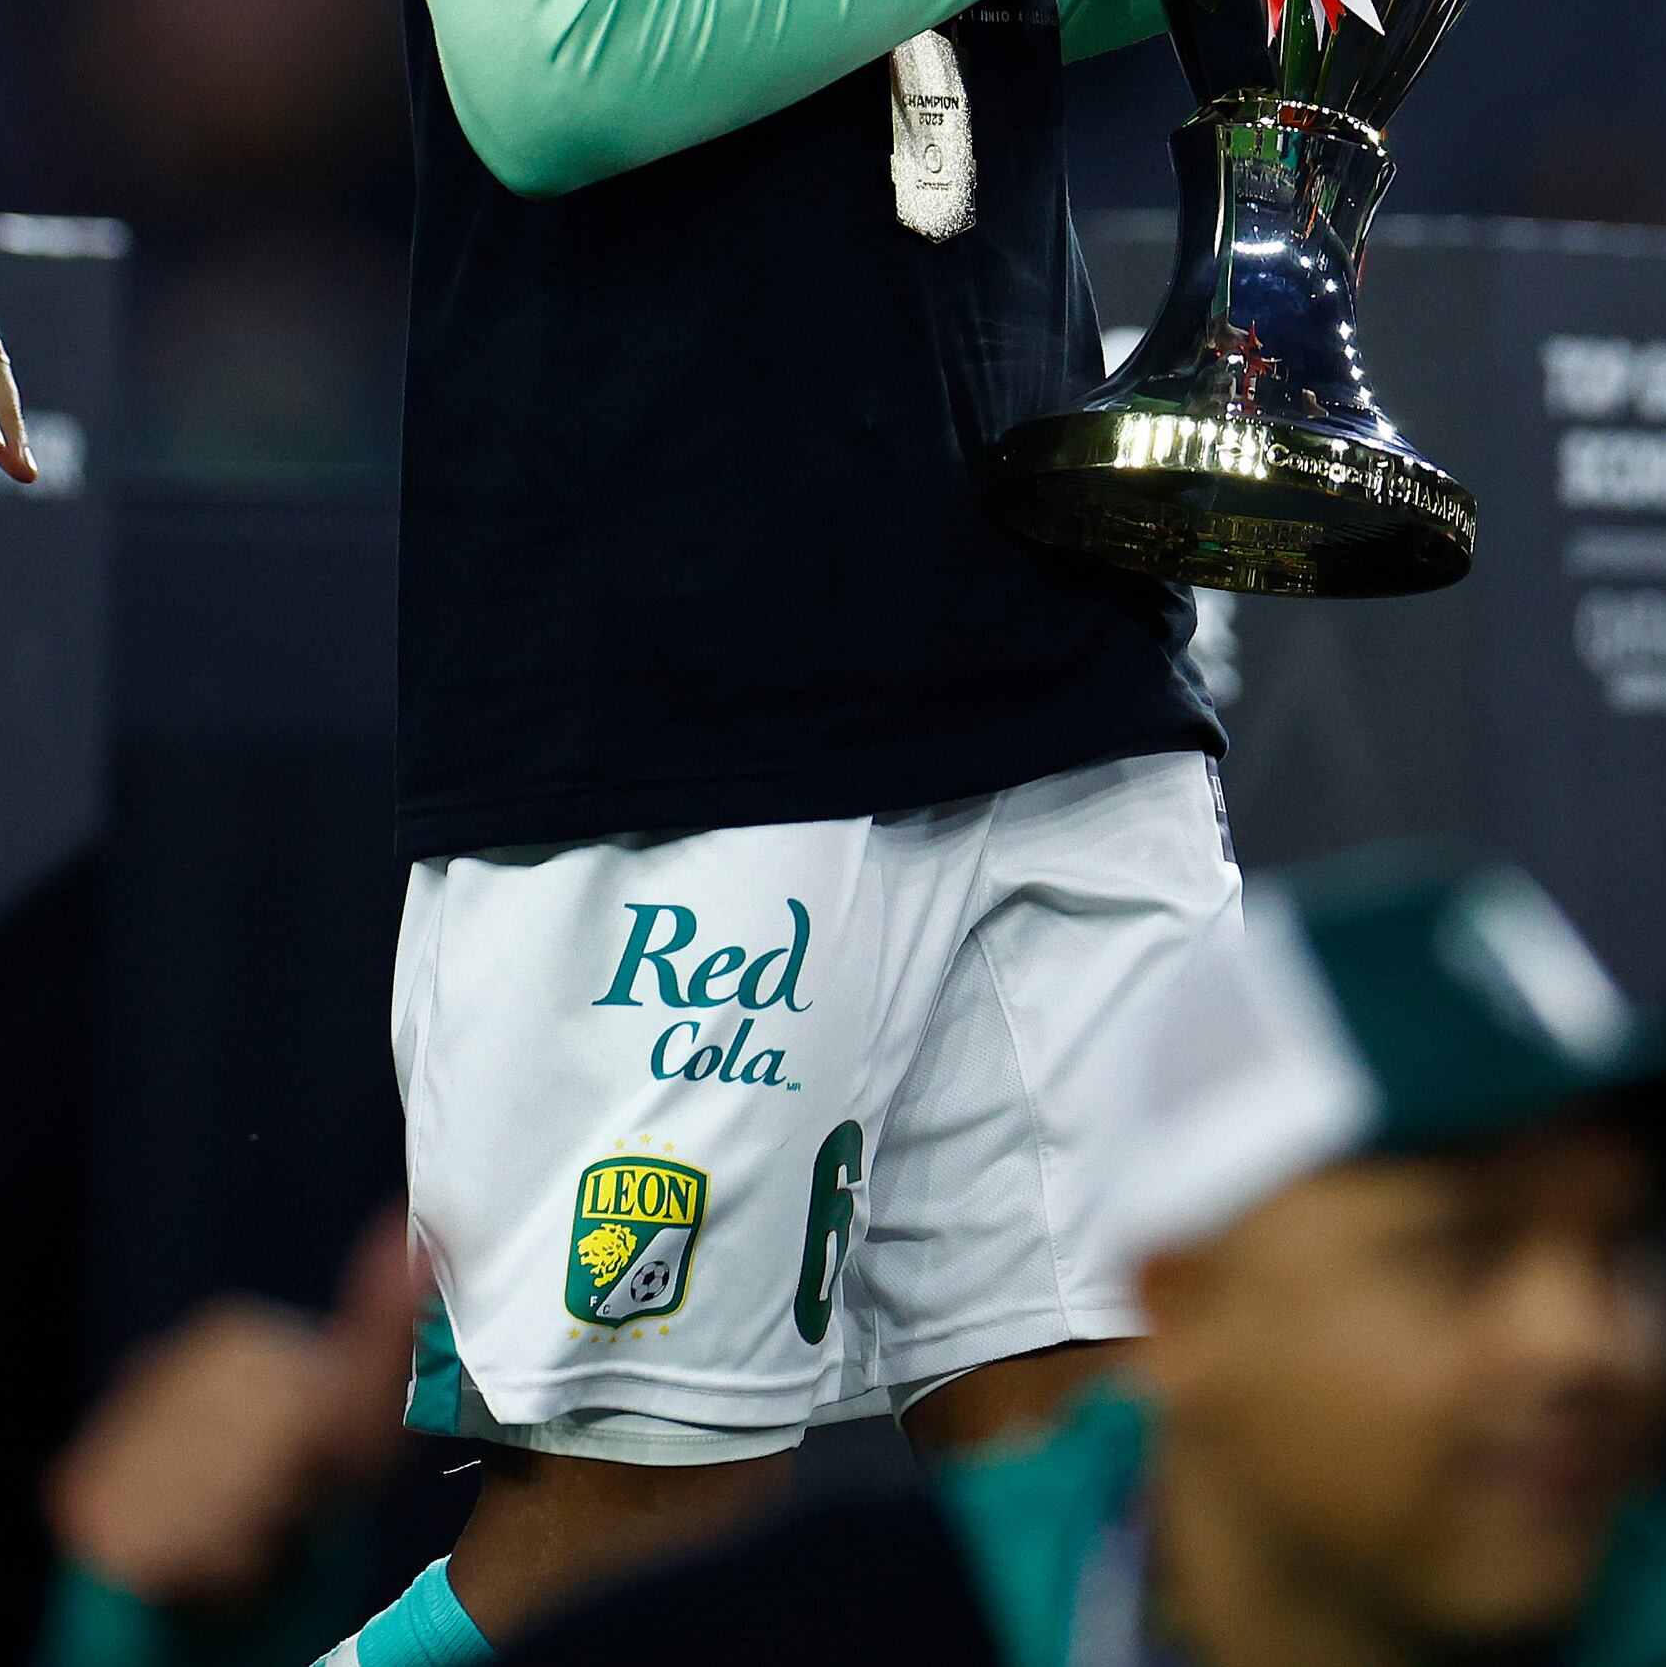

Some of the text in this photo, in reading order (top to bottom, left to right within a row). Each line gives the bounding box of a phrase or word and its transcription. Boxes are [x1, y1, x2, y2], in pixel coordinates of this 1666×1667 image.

[902, 94, 959, 110] CHAMPION
[591, 897, 814, 1013] Red
[650, 1018, 787, 1087] Cola
[587, 1171, 694, 1221] LEON
[793, 1119, 864, 1345] 6
